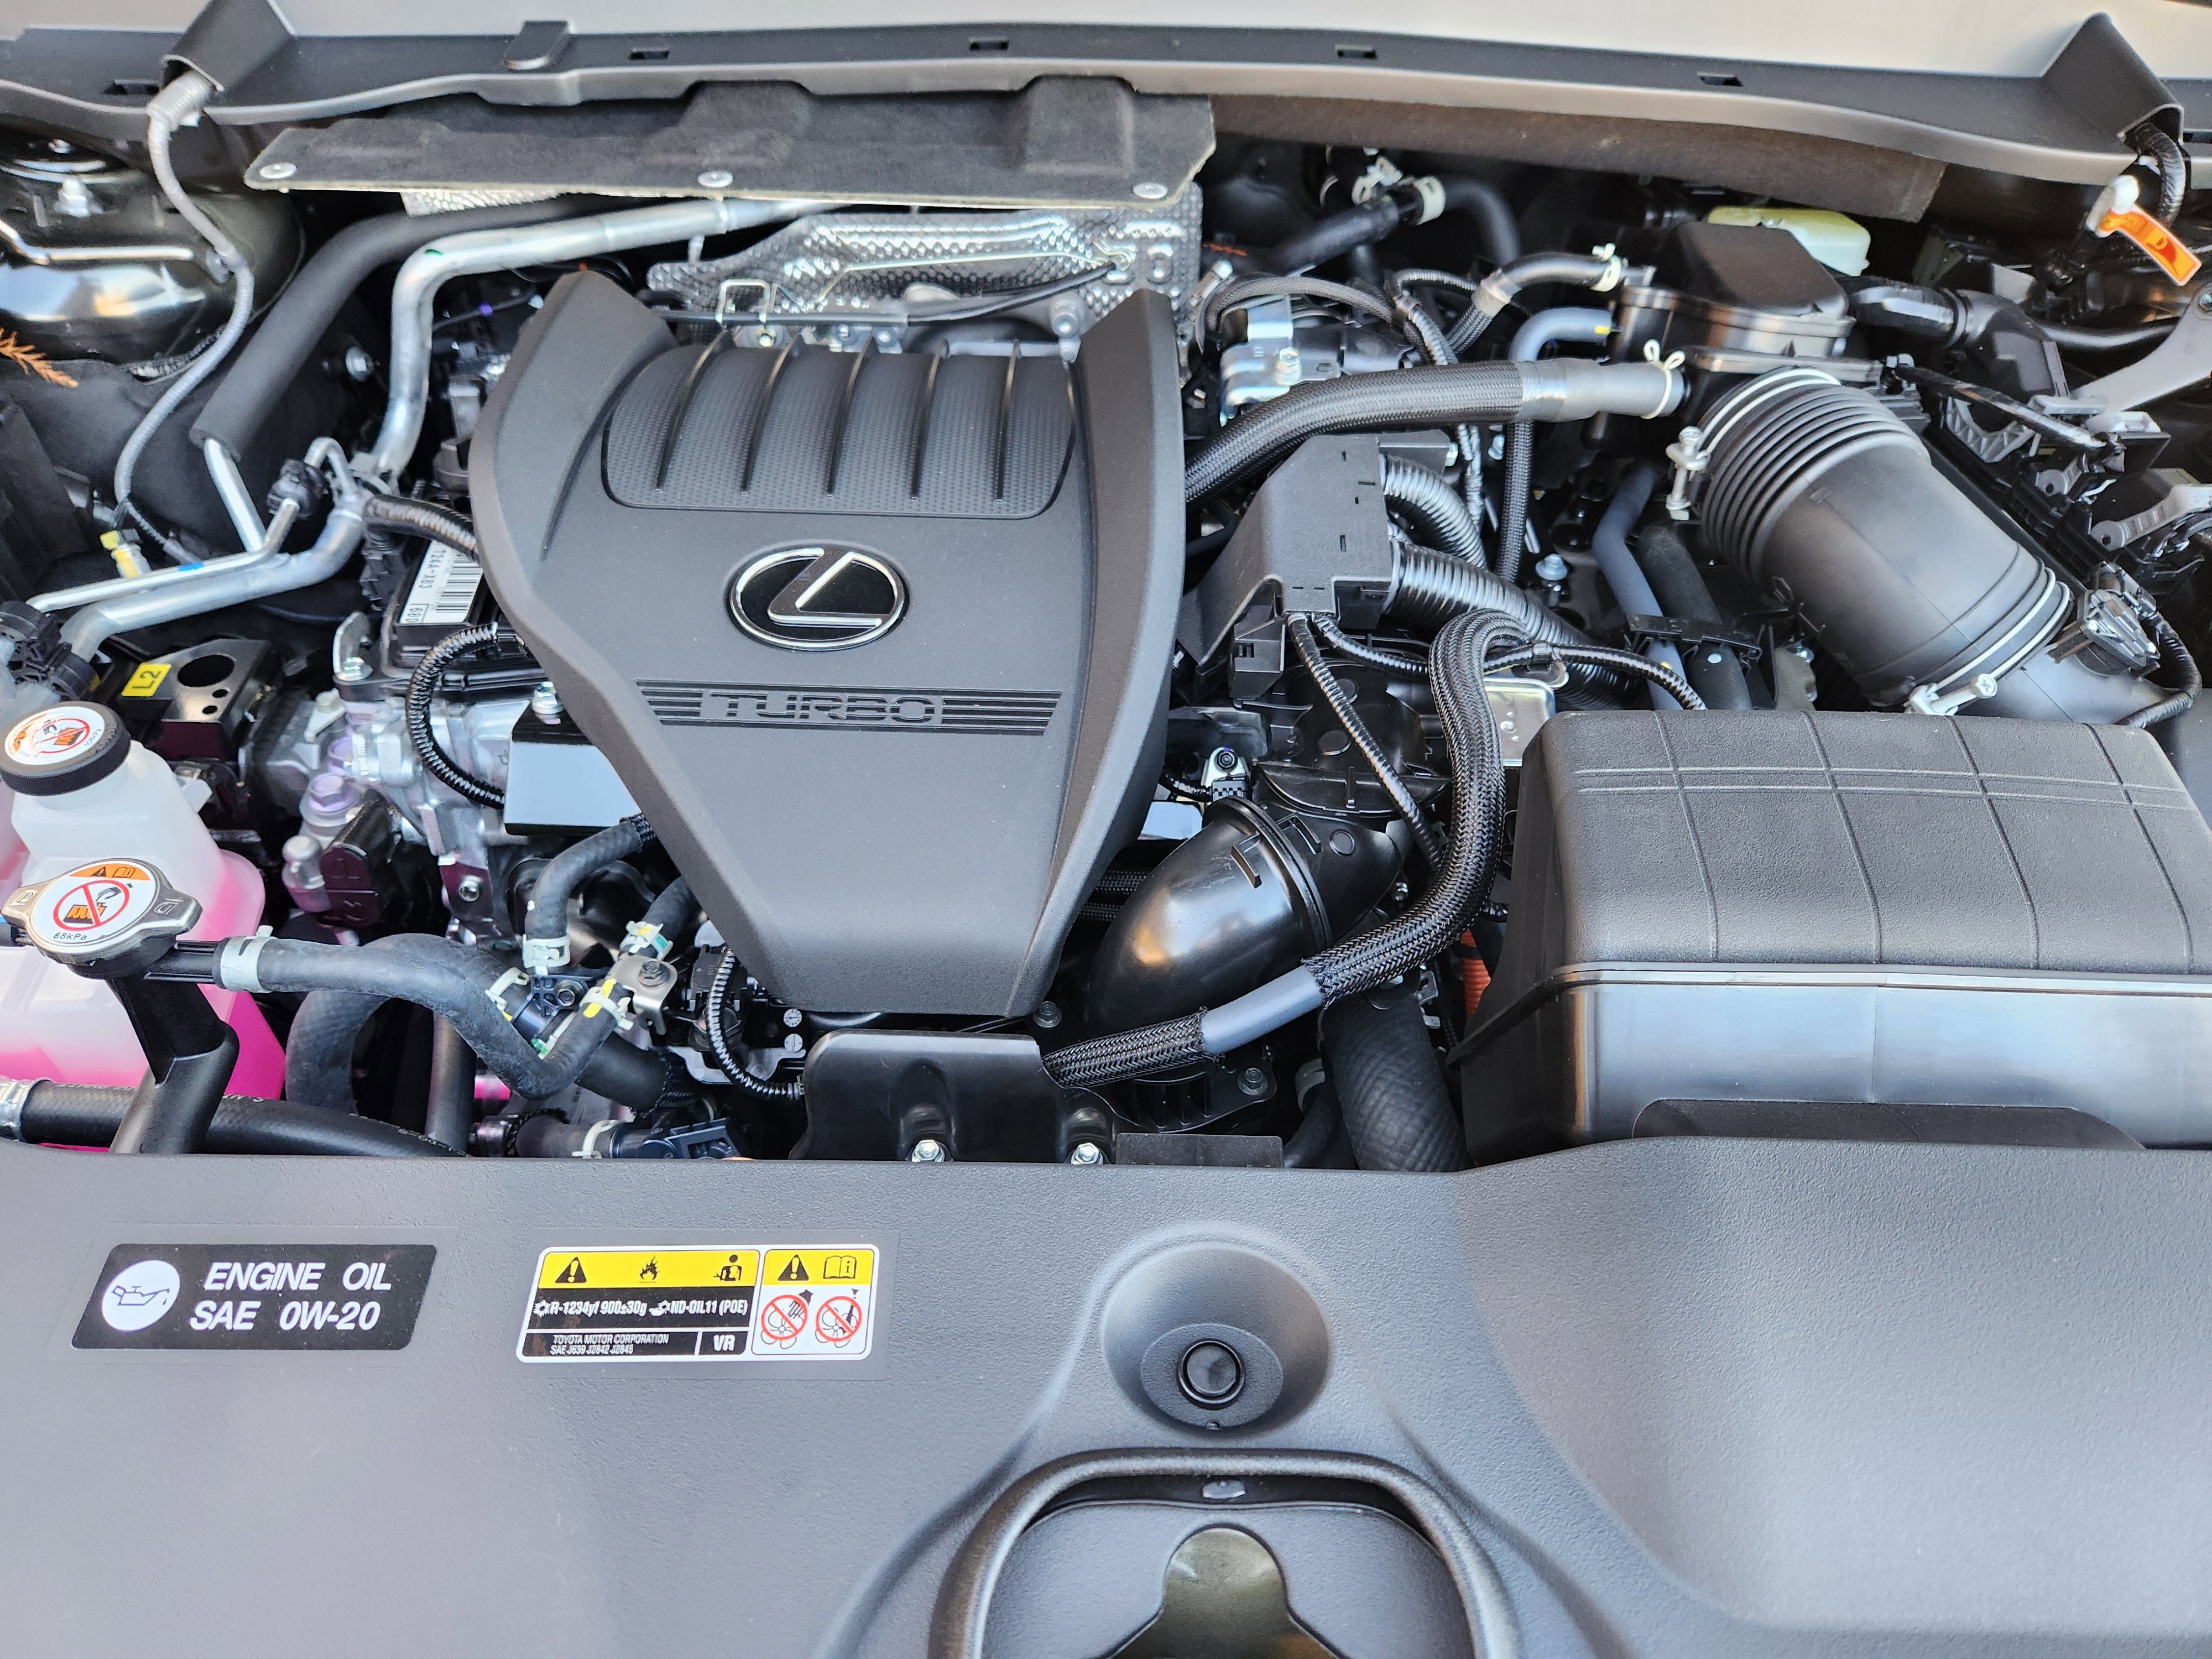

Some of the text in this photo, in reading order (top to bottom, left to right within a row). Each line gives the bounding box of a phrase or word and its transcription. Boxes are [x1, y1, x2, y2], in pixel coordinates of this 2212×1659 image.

[132, 670, 161, 689] L2
[711, 691, 936, 723] TURBO
[53, 932, 87, 941] 88kPa
[204, 1261, 392, 1291] ENGINE OIL
[190, 1301, 380, 1331] SAE 0W-20
[669, 1300, 718, 1314] ND-OIL11
[718, 1300, 748, 1316] (POE)
[553, 1333, 670, 1345] TOYOTA MOTOR CORPORATION
[713, 1334, 735, 1352] VR
[549, 1344, 566, 1355] SAE
